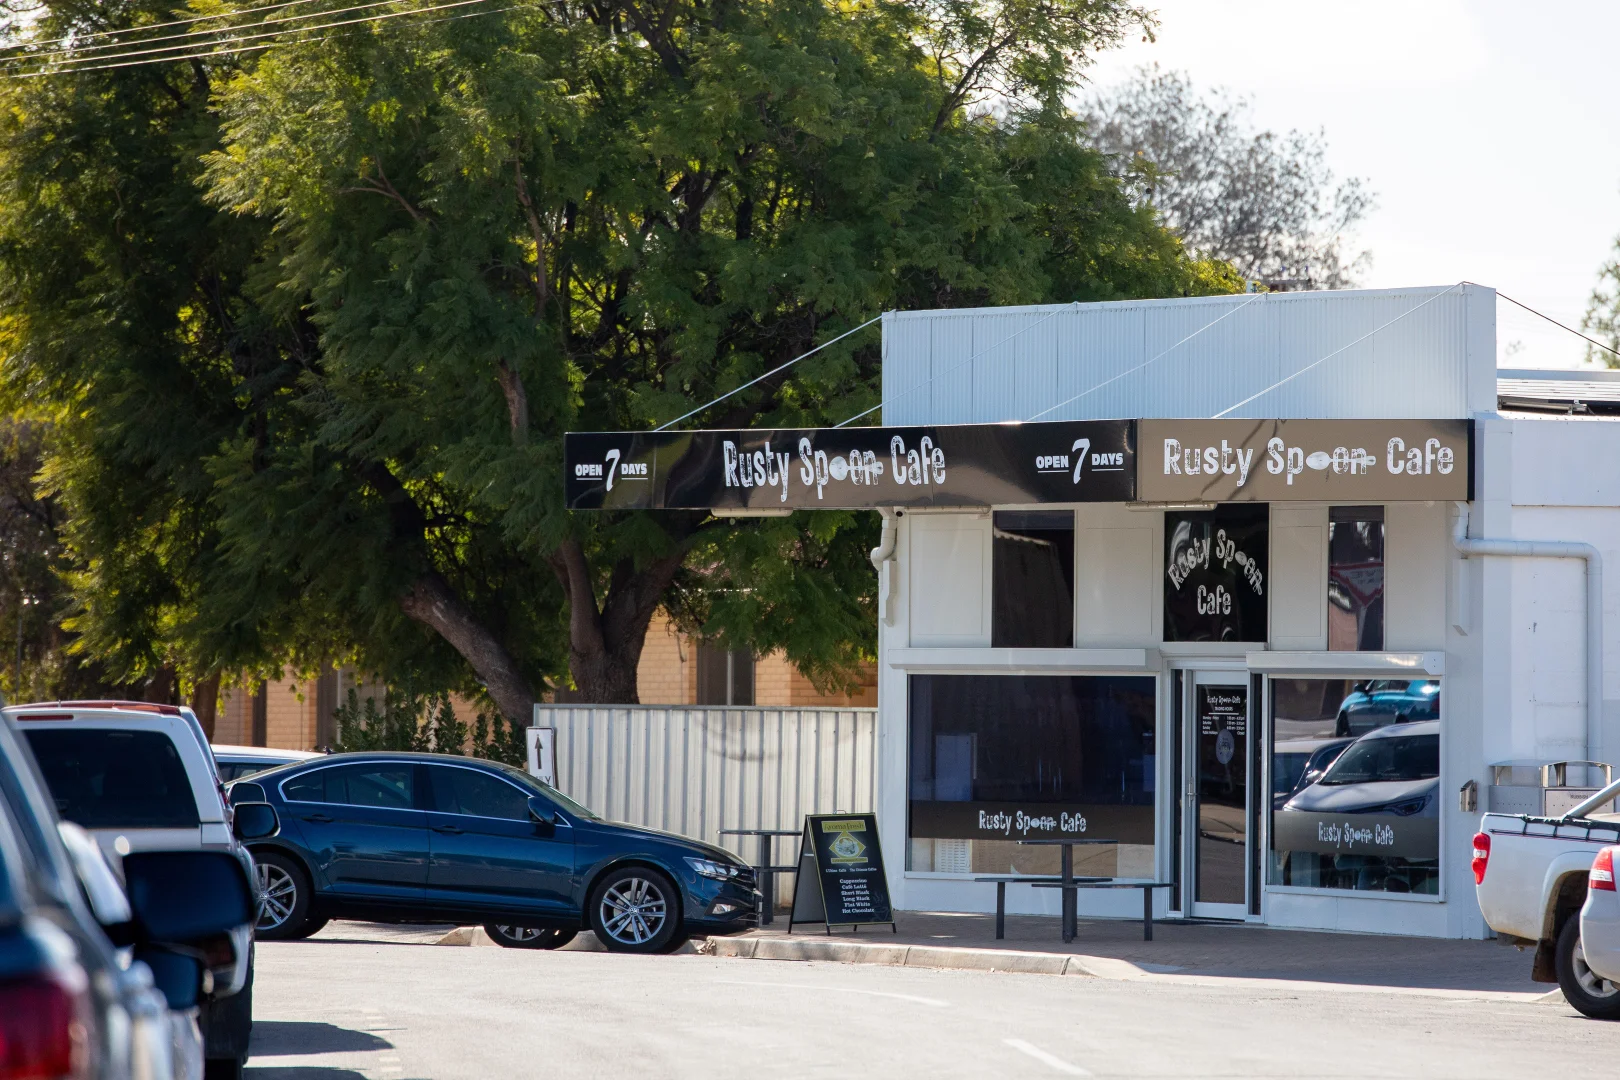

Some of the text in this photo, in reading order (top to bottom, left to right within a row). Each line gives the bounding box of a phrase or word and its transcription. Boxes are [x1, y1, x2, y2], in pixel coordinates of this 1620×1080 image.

[575, 448, 648, 492] OPEN 7 DAYS
[723, 440, 789, 502] Rusty
[891, 435, 946, 485] Cafe
[1035, 438, 1124, 485] OPEN 7 DAYS
[1163, 438, 1254, 487] Rusty
[1386, 436, 1454, 476] Cafe
[1167, 536, 1211, 591] Rusty
[1197, 584, 1231, 615] Cafe
[979, 810, 1012, 835] Rusty
[1060, 811, 1086, 832] Cafe
[1318, 821, 1342, 848] Rusty
[1375, 823, 1394, 845] Cafe
